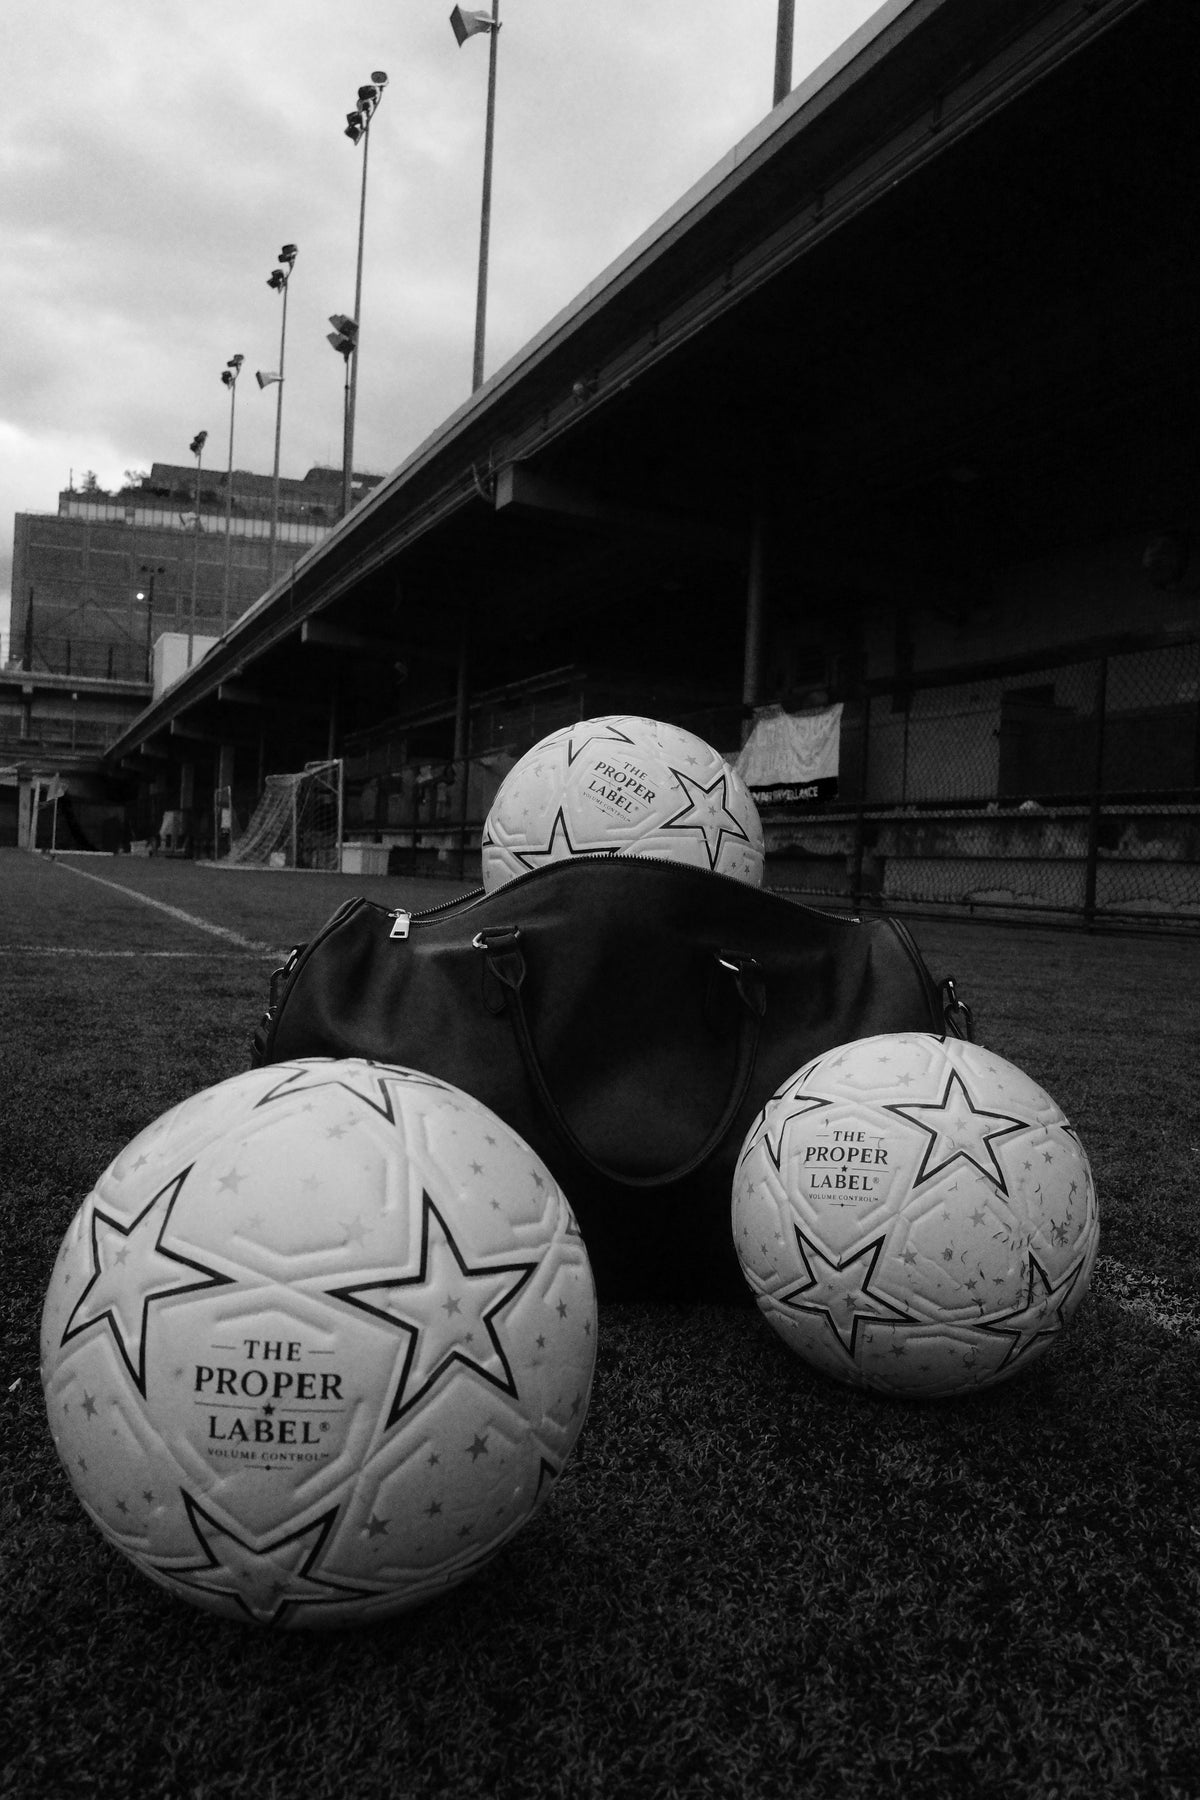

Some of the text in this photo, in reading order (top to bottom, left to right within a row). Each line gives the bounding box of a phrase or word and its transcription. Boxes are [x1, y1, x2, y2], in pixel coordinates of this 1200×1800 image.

[623, 761, 648, 780] THE
[594, 761, 656, 804] PROPER
[833, 1130, 866, 1142] THE
[805, 1146, 888, 1165] PROPER
[244, 1339, 302, 1362] THE
[194, 1365, 344, 1400] PROPER
[207, 1447, 257, 1460] VOLUME
